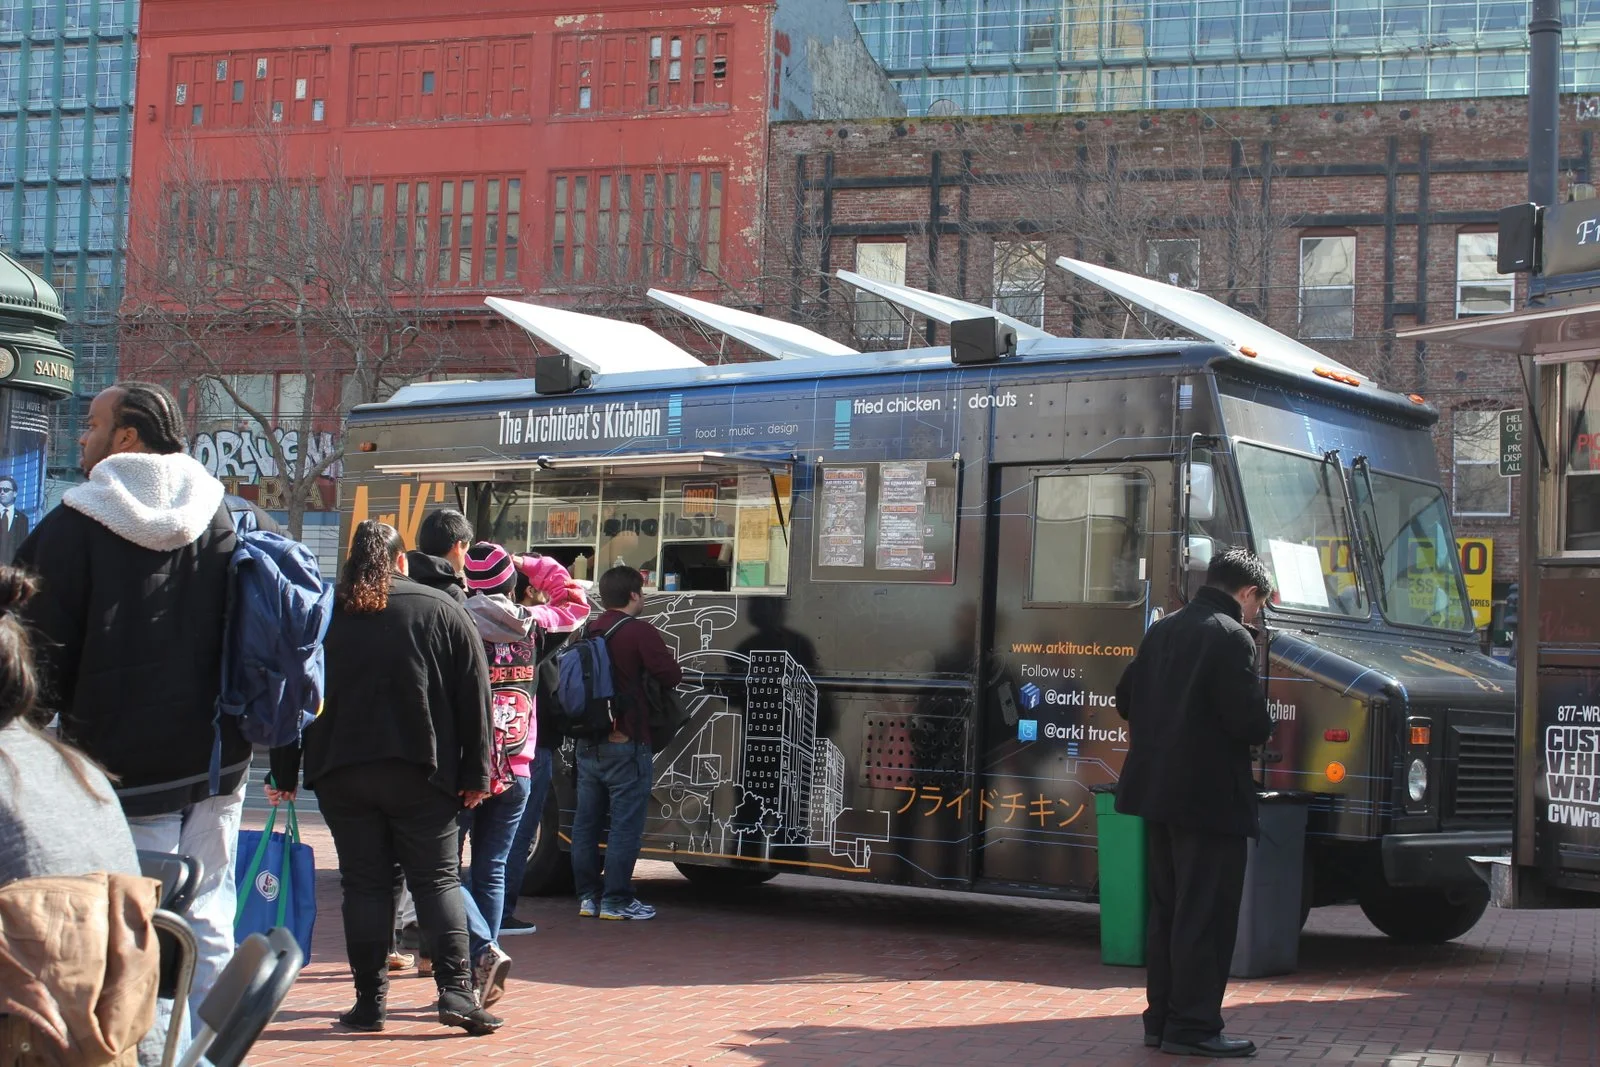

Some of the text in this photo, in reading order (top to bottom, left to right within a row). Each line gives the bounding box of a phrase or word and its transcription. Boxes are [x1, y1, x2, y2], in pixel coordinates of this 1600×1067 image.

[35, 359, 58, 377] SAN
[853, 398, 883, 415] fried
[886, 396, 941, 413] chicken
[968, 391, 1017, 409] donuts
[498, 401, 661, 445] The Architect's Kitchen
[694, 425, 717, 440] food
[728, 423, 755, 437] music
[767, 420, 799, 438] design
[685, 488, 715, 513] ORDER
[1011, 642, 1134, 657] www.arkitruck.com
[1020, 663, 1060, 677] Follow
[1062, 668, 1076, 678] us
[1044, 688, 1117, 708] @arki truc
[1264, 698, 1296, 721] tchen
[1557, 705, 1600, 723] 877-WR
[1043, 722, 1128, 743] @arki truck
[893, 786, 1085, 828] フライドチキン
